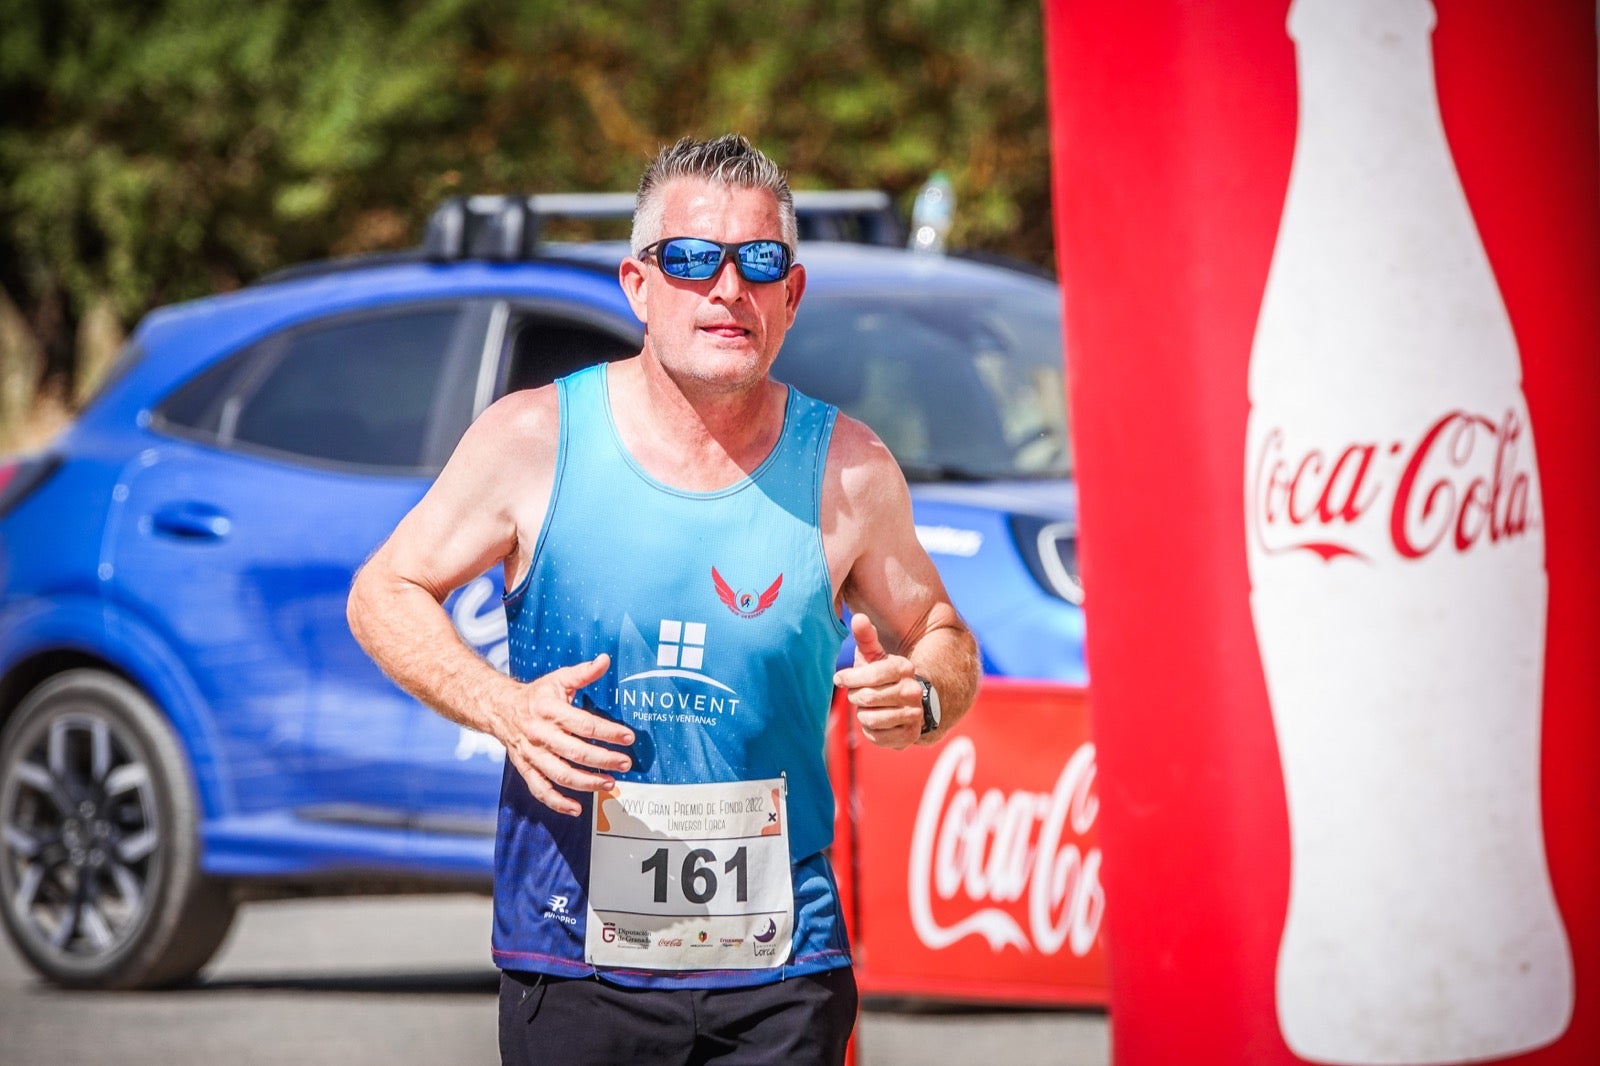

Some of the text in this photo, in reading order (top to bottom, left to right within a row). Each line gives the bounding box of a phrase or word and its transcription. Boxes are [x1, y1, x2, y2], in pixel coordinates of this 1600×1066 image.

[1254, 407, 1537, 566] Coca-Cola
[615, 688, 740, 715] INNOVENT
[633, 711, 717, 726] PUERTAS Y VENTANAS
[647, 801, 670, 816] GRAN
[674, 801, 703, 816] PREMIO
[706, 803, 716, 815] DE
[720, 799, 744, 815] FONDO
[745, 796, 764, 813] 2022
[667, 818, 726, 832] UNIVERSO LORCA
[907, 735, 1104, 958] Coca-Co
[641, 846, 748, 904] 161
